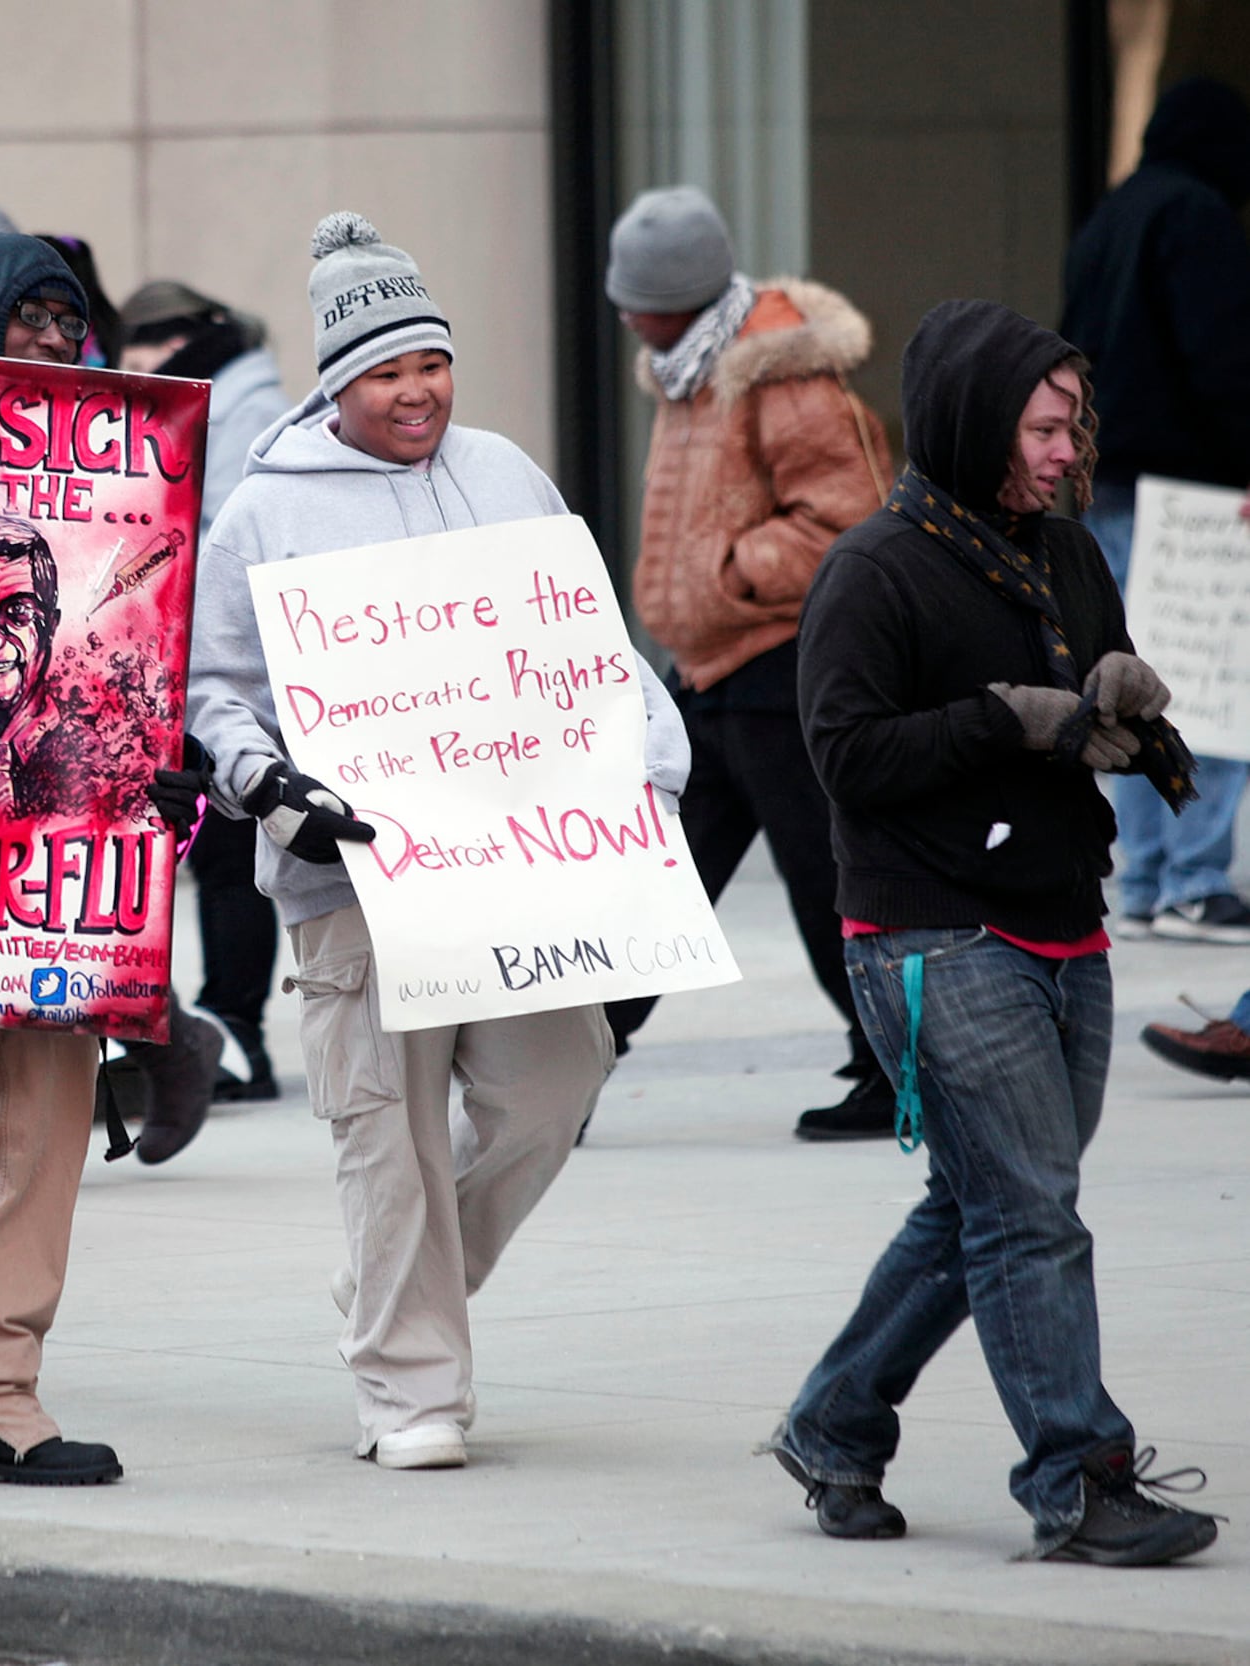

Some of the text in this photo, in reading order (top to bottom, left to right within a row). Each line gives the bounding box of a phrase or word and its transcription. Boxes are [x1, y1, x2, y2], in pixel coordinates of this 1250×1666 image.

[278, 569, 599, 655] Restore the
[284, 648, 631, 736] Democratic Rights
[337, 717, 599, 785] of the People of
[352, 779, 679, 882] Detroit NOW!
